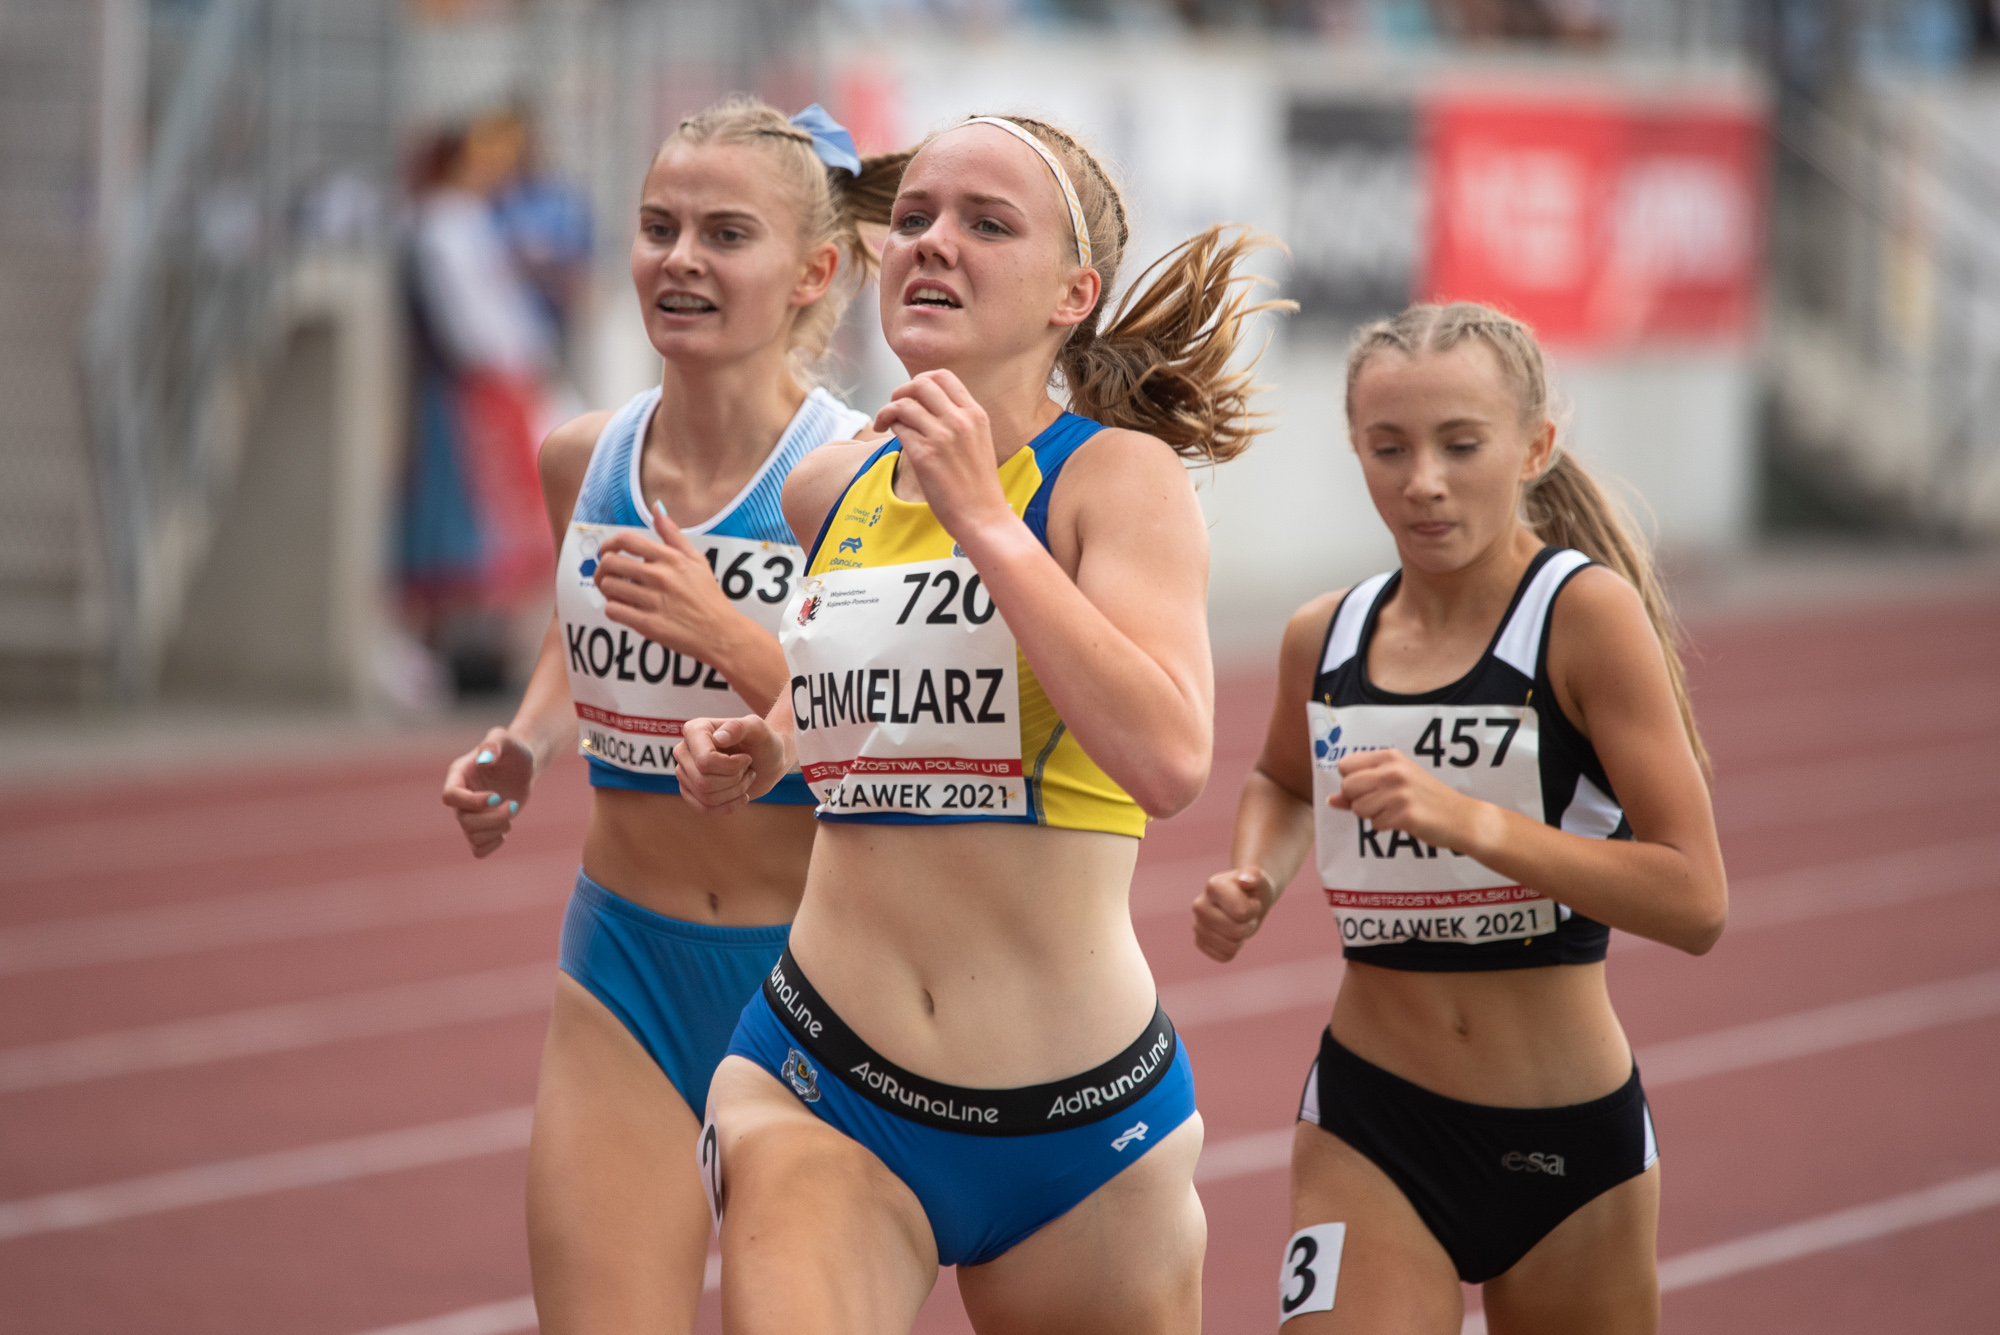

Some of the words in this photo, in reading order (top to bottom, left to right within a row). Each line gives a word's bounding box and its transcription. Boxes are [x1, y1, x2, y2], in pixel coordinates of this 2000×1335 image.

[896, 570, 996, 625] 720
[791, 668, 1006, 731] CHMIELARZ
[1414, 718, 1521, 768] 457
[810, 766, 828, 778] 53
[925, 762, 979, 772] POLSKI
[982, 763, 1010, 774] U18
[942, 785, 1008, 808] 2021
[1456, 889, 1510, 904] POLSKI
[1475, 908, 1538, 938] 2021
[1502, 1151, 1565, 1176] esa
[1282, 1235, 1319, 1314] 3
